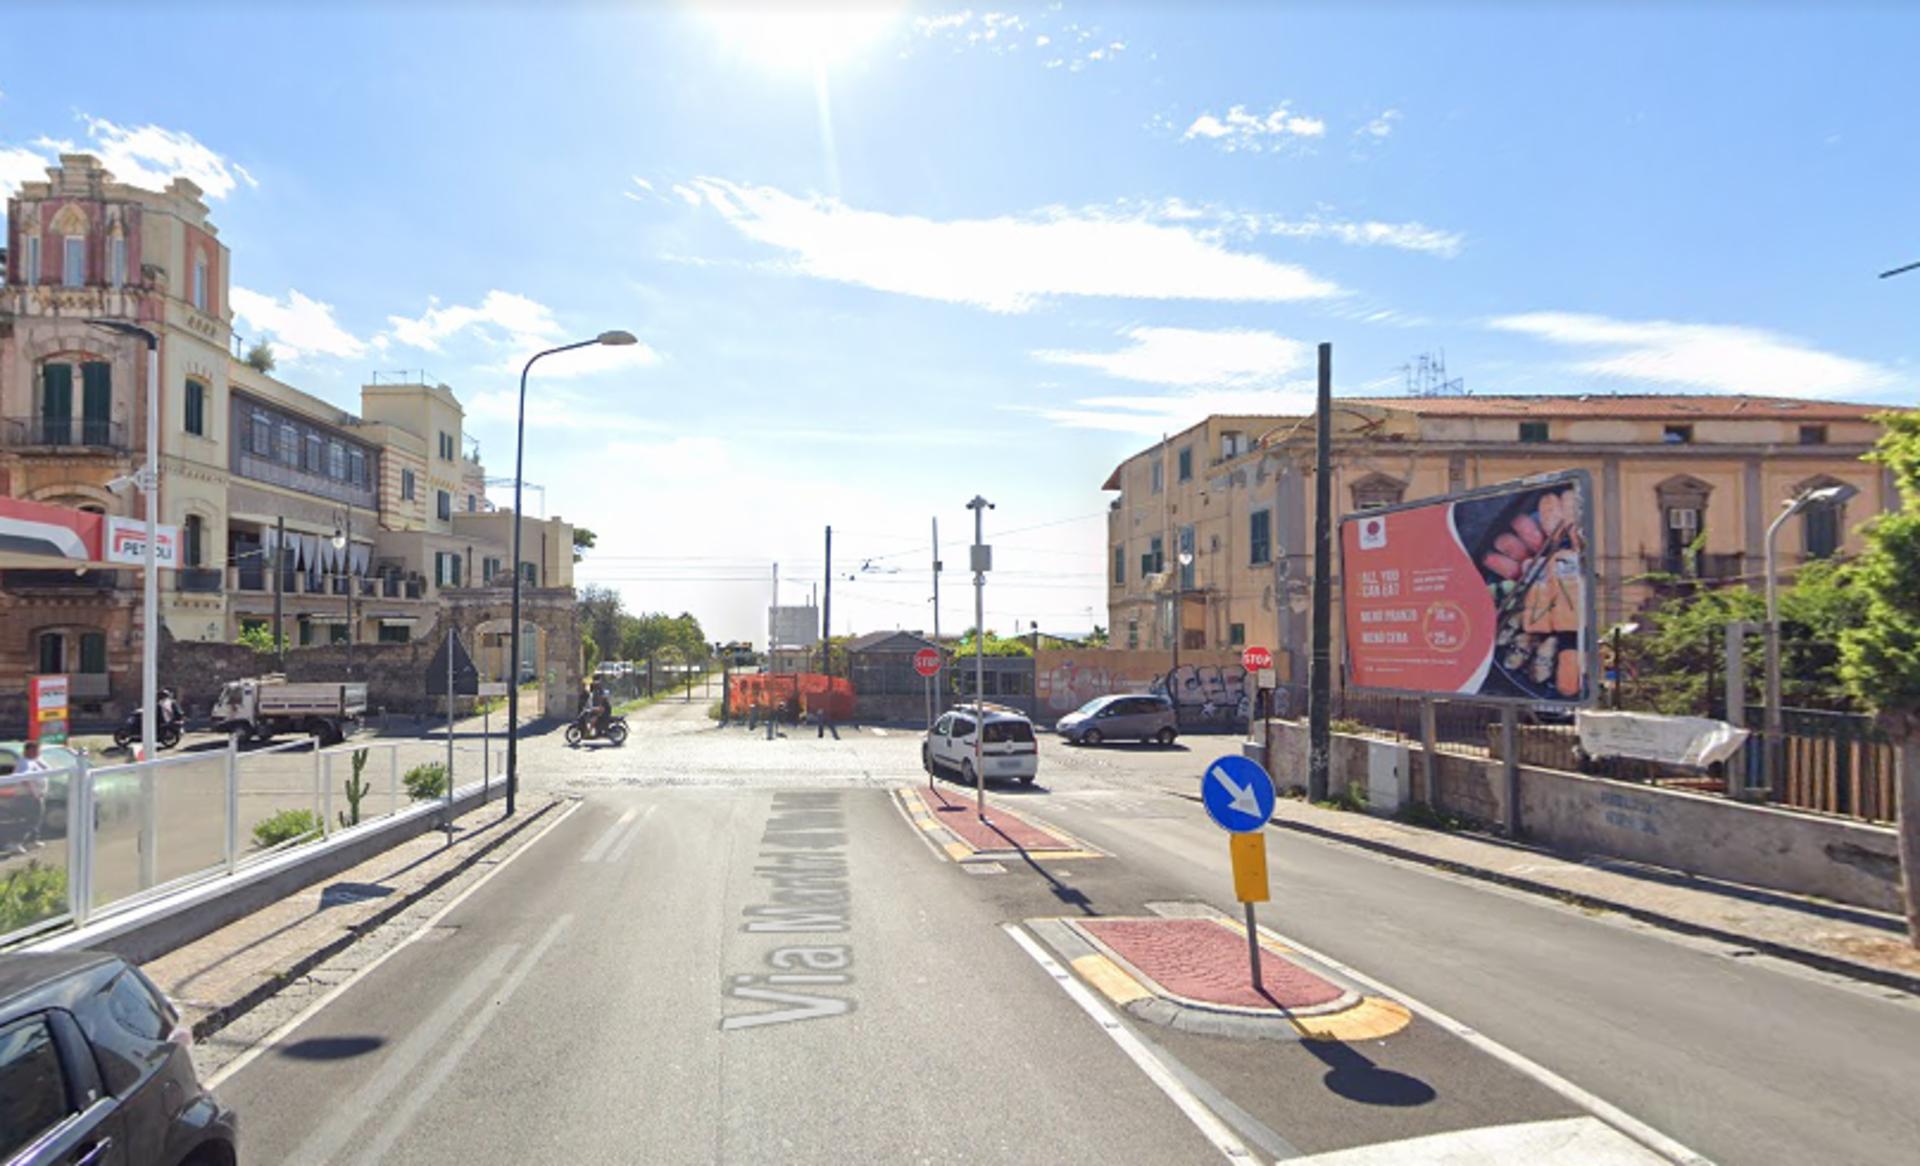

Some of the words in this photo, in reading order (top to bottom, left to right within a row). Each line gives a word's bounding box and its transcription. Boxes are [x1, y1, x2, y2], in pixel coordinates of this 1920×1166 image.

[123, 541, 172, 560] PETOLI
[1362, 571, 1378, 584] ALL
[1380, 569, 1399, 582] YOU
[1362, 584, 1380, 598] CAN
[1382, 582, 1399, 597] EAT
[914, 655, 941, 667] STOP
[1244, 653, 1271, 666] STOP
